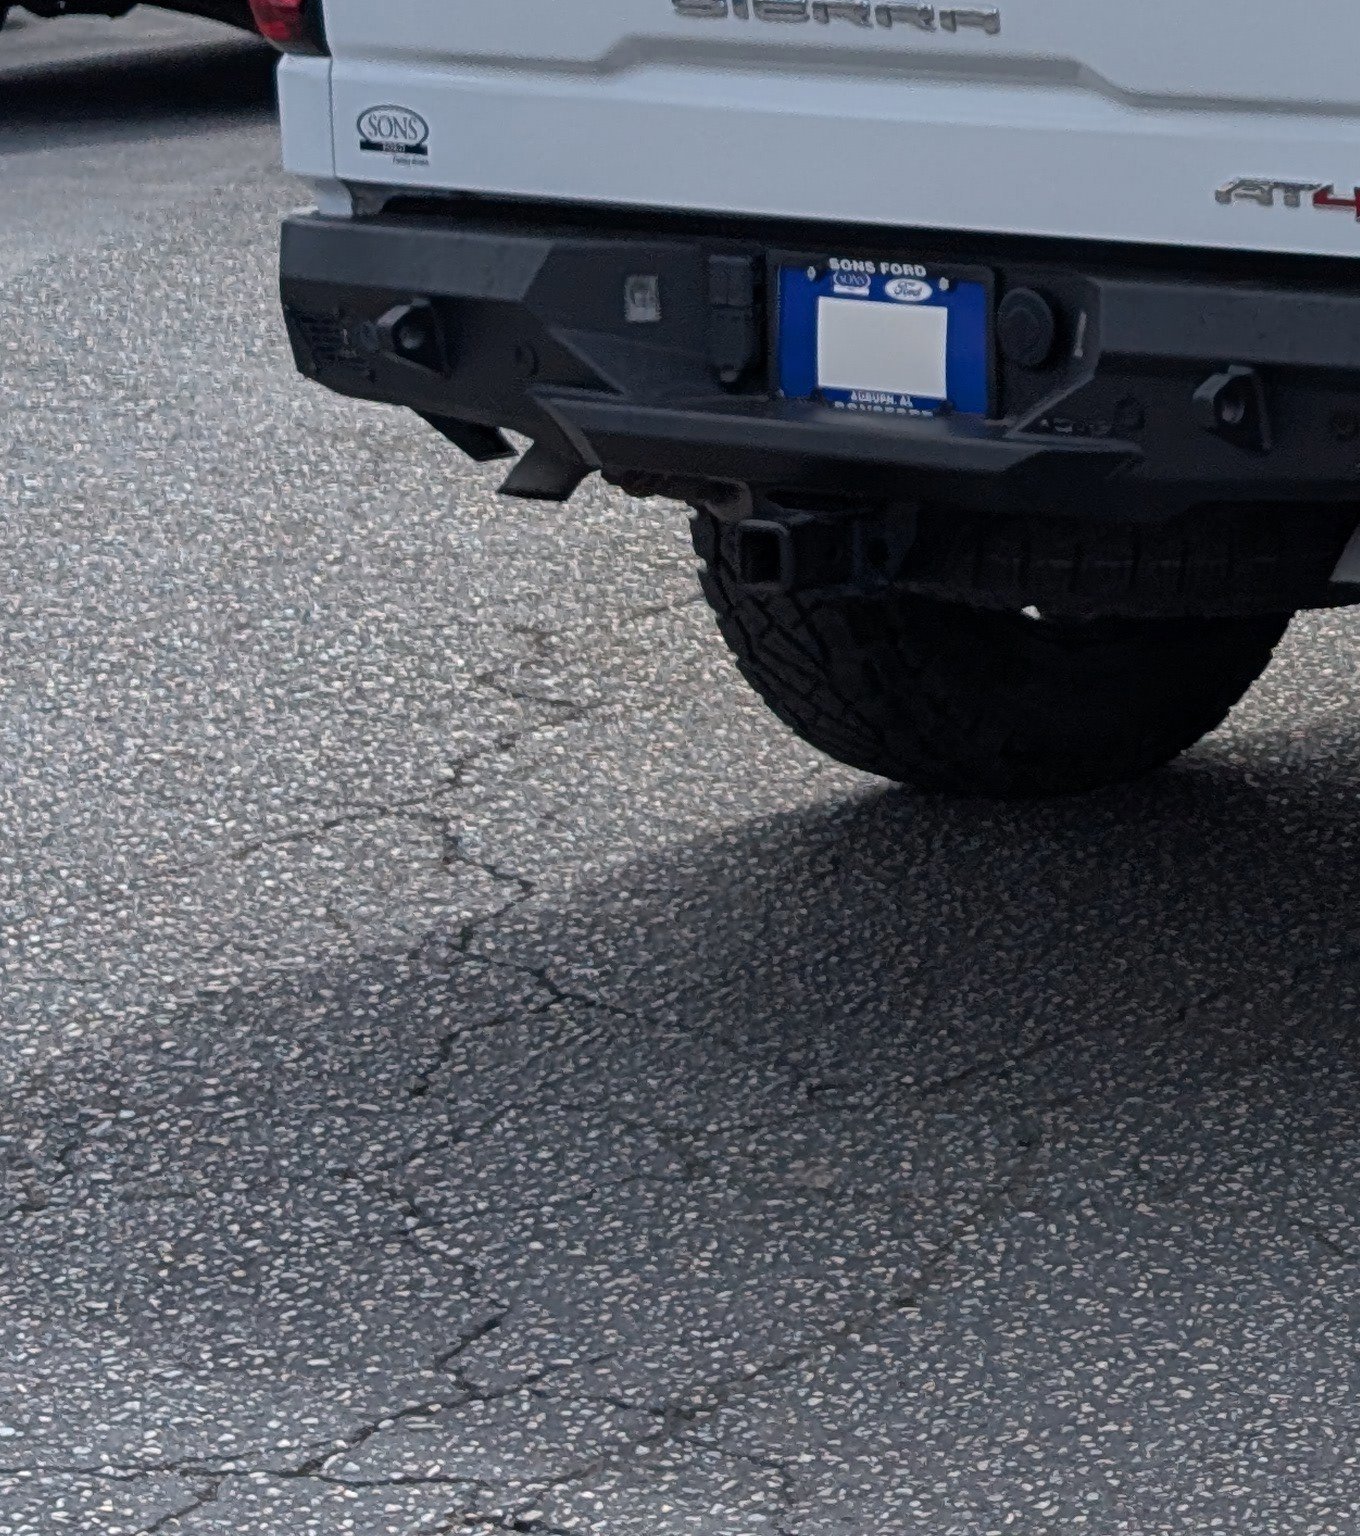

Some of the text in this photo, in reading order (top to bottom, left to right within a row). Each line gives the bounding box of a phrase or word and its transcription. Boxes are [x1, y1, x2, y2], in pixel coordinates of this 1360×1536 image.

[367, 113, 418, 140] SONS
[829, 257, 927, 278] SONS FORD
